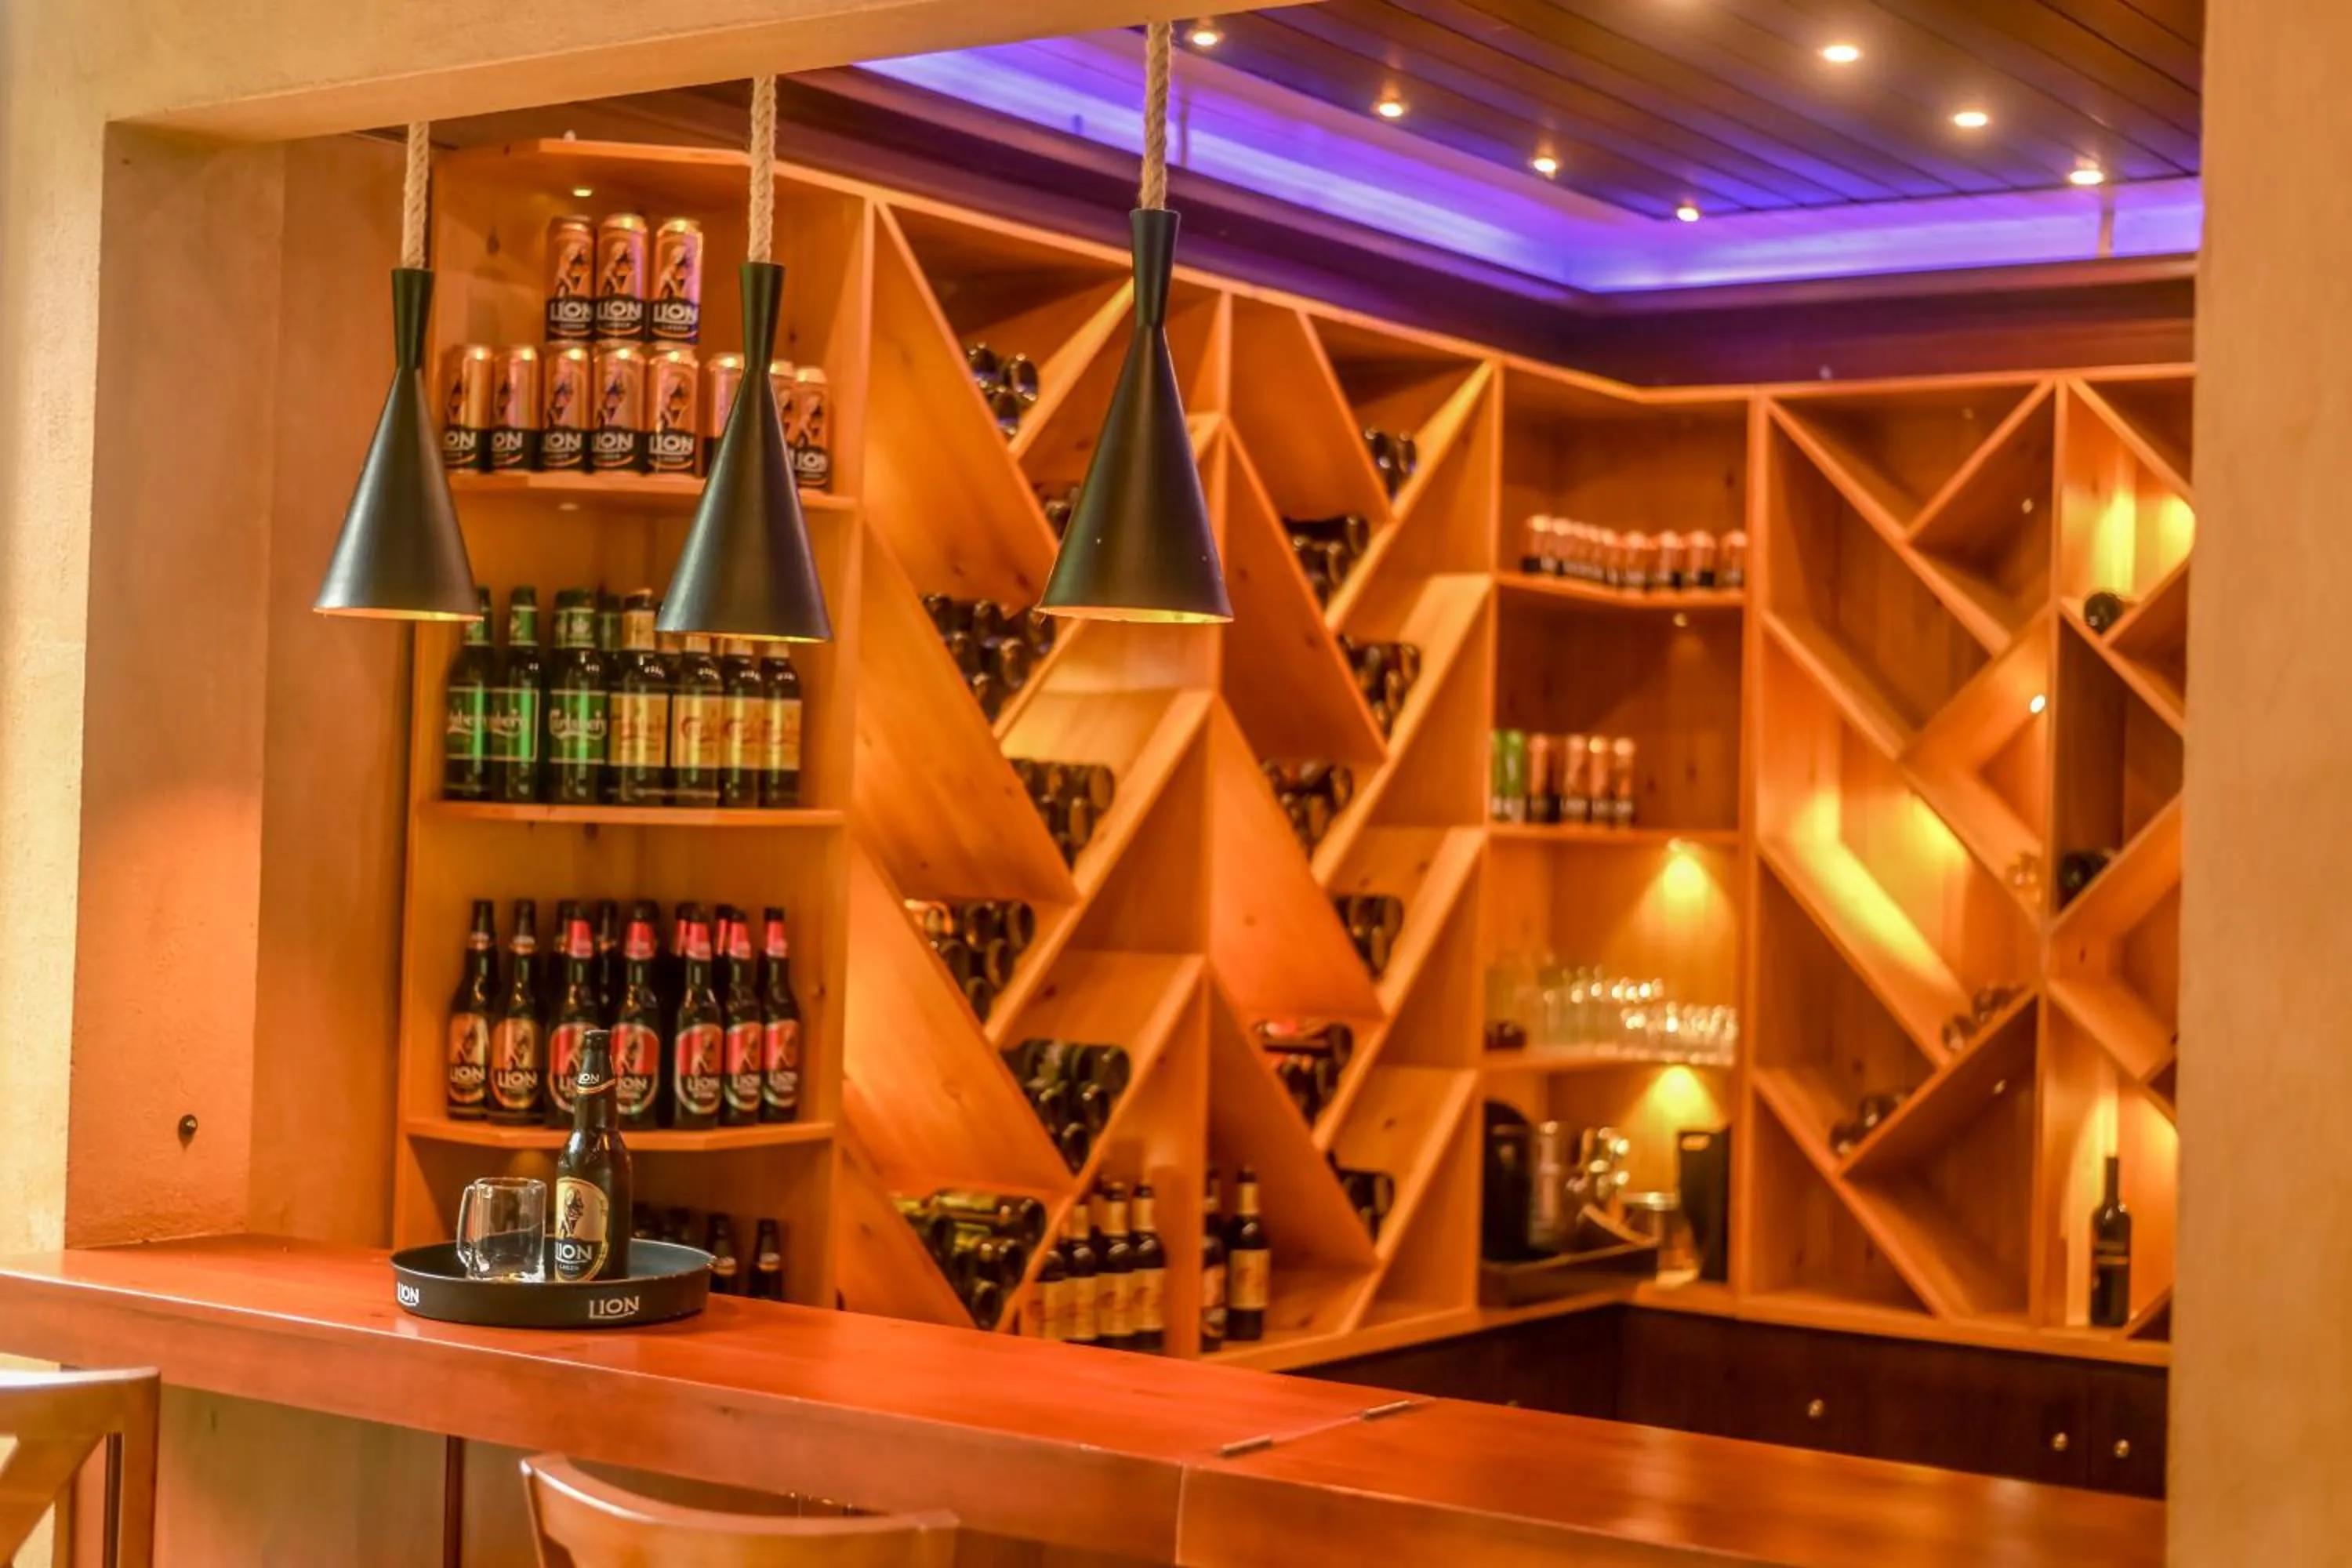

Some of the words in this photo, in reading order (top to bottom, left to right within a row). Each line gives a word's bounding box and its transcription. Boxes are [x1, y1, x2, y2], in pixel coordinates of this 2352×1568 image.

[596, 299, 643, 322] LION
[652, 303, 699, 325] LION
[543, 432, 583, 452] ION
[648, 435, 695, 456] LION
[451, 1065, 485, 1083] LION
[497, 1070, 539, 1089] LION
[615, 1075, 648, 1091] ION
[397, 1281, 420, 1307] LION
[589, 1295, 641, 1320] LION
